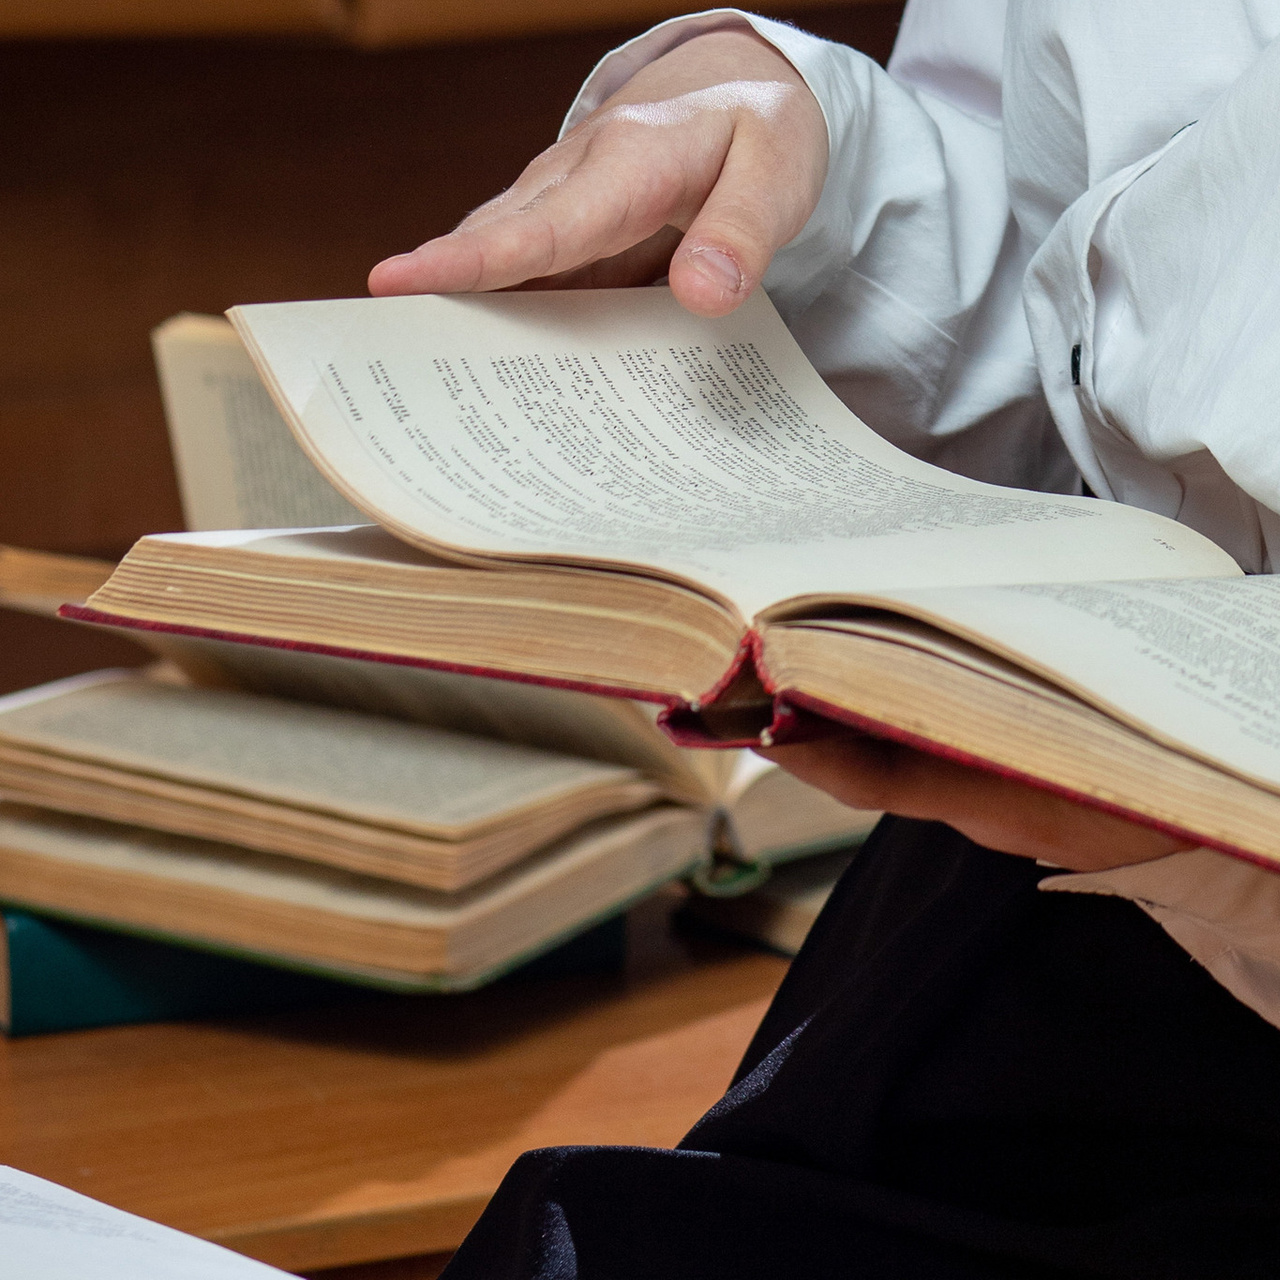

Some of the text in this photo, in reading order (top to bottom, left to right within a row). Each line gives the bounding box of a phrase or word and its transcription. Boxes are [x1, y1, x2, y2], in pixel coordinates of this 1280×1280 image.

[702, 358, 748, 412] аэродром,
[710, 343, 754, 396] каратель-
[719, 342, 775, 410] сопровожда-
[737, 341, 774, 386] мнимые
[745, 341, 811, 418] ожесточенным
[751, 400, 785, 429] время
